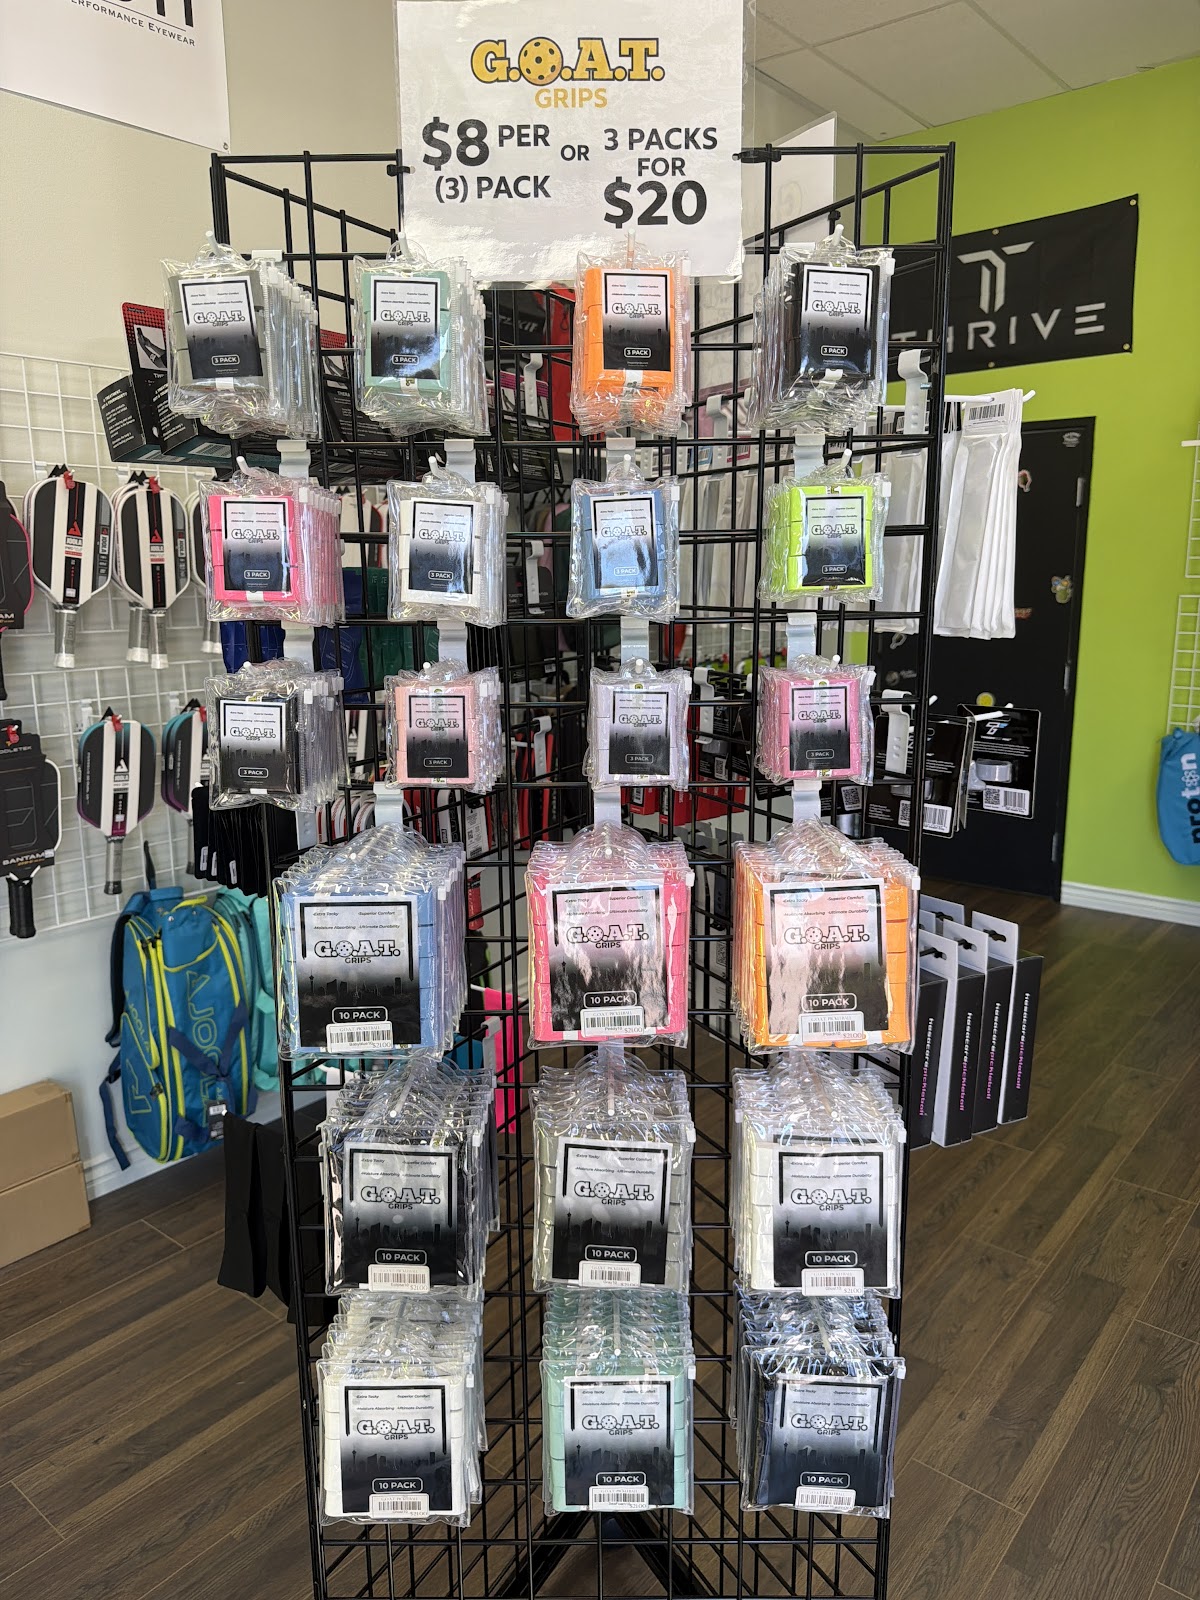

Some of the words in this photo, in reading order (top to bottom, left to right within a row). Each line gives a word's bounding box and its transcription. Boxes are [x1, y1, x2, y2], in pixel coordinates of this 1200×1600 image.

[470, 37, 665, 86] G.O.A.T.
[534, 88, 608, 108] GRIPS
[422, 116, 490, 171] $8
[498, 124, 550, 148] PER
[604, 128, 618, 151] 3
[628, 127, 718, 150] PACKS
[560, 144, 590, 162] OR
[637, 157, 686, 177] FOR
[435, 176, 469, 204] (3)
[476, 175, 552, 199] PACK
[604, 176, 708, 229] $20
[566, 924, 649, 943] G.O.A.T.
[784, 925, 869, 944] G.O.A.T.
[314, 940, 400, 957] G.O.A.T.
[361, 1186, 441, 1204] G.O.A.T.
[574, 1181, 654, 1201] G.O.A.T.
[791, 1188, 872, 1205] G.O.A.T.
[604, 1250, 630, 1258] PACK
[357, 1420, 435, 1435] G.O.A.T.
[582, 1415, 659, 1430] G.O.A.T.
[791, 1413, 868, 1431] G.O.A.T.
